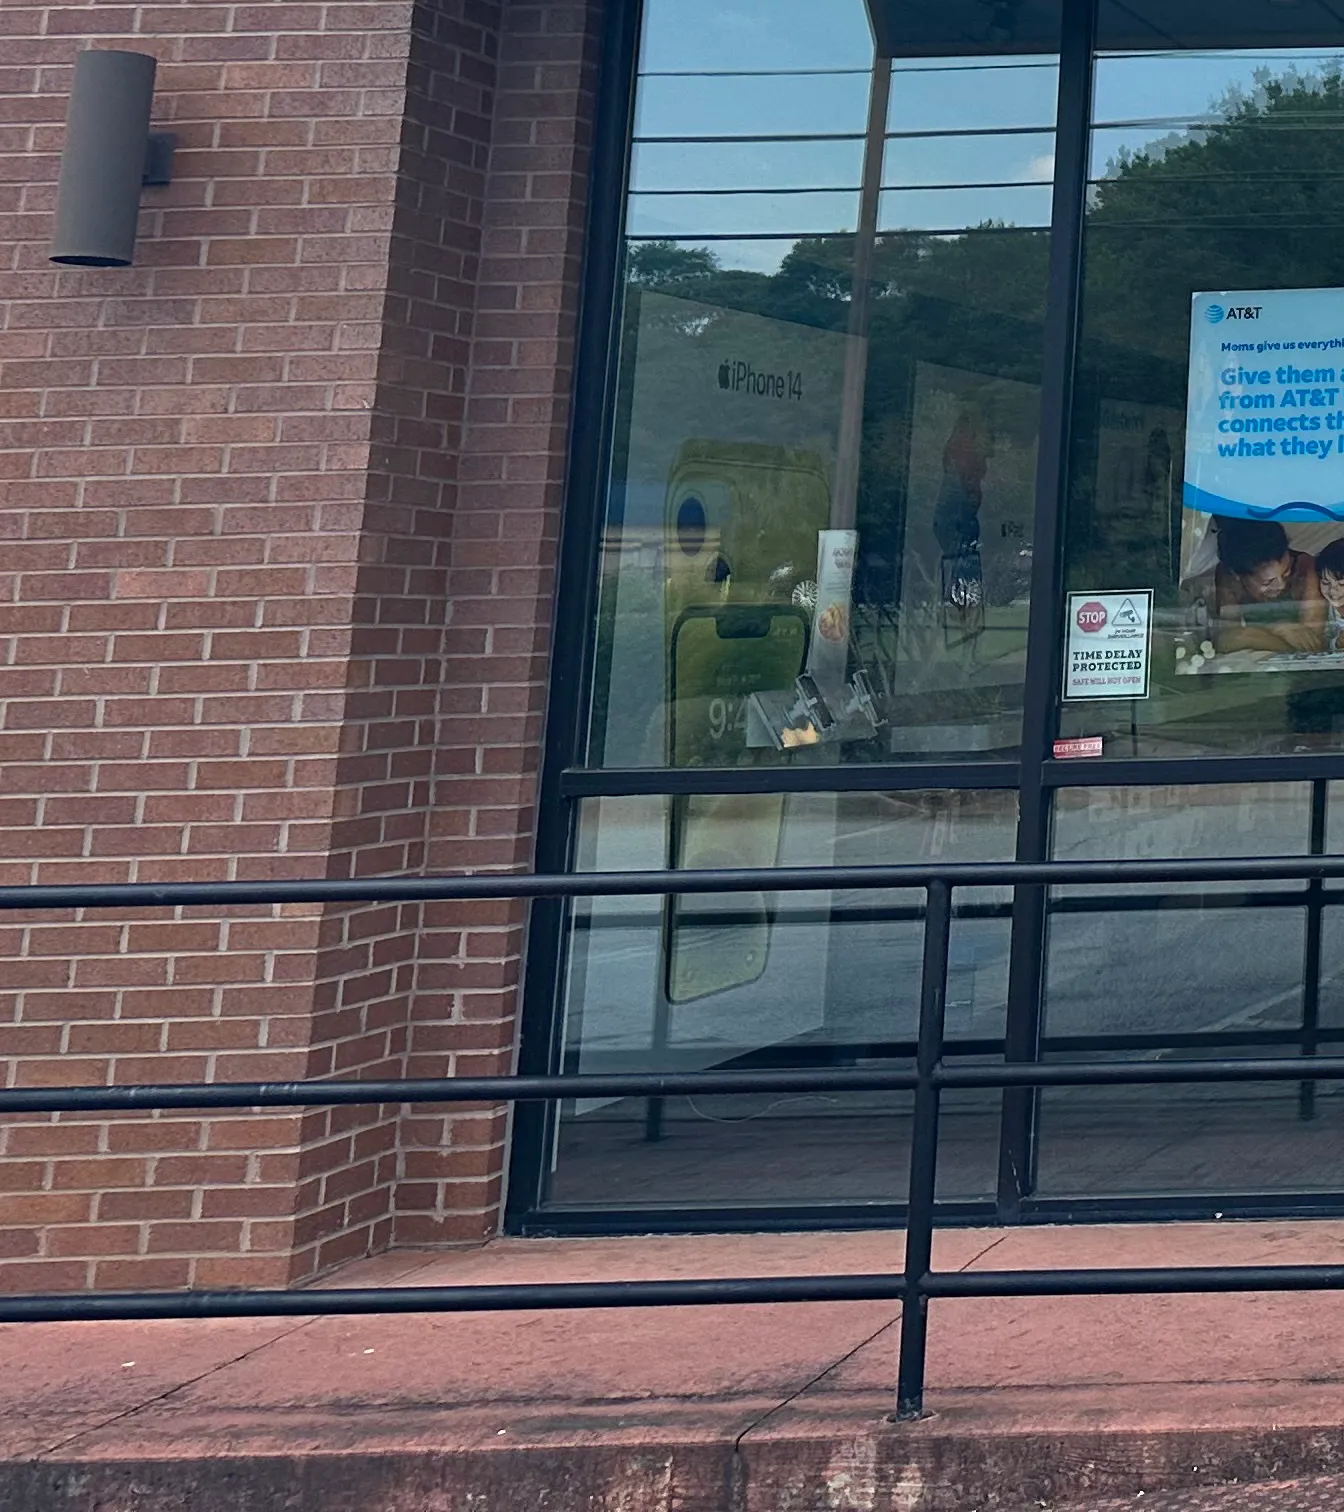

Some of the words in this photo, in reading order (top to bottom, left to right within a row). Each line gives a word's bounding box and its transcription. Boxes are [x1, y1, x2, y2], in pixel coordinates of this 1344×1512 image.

[1226, 306, 1262, 320] AT&T
[1221, 342, 1254, 352] Moms
[1257, 341, 1281, 353] give
[1283, 342, 1295, 350] us
[732, 360, 785, 399] iPhone
[787, 370, 803, 400] 14
[1221, 366, 1271, 385] Give
[1276, 365, 1335, 384] them
[1218, 390, 1275, 410] from
[1280, 388, 1339, 408] AT&T
[1218, 414, 1320, 433] connects
[1218, 437, 1276, 457] what
[1280, 436, 1333, 459] they
[1079, 611, 1105, 624] STOP
[1073, 650, 1102, 661] TIME
[1105, 649, 1143, 659] DELAY
[1072, 661, 1142, 672] PROTECTED
[709, 697, 747, 739] 9:4
